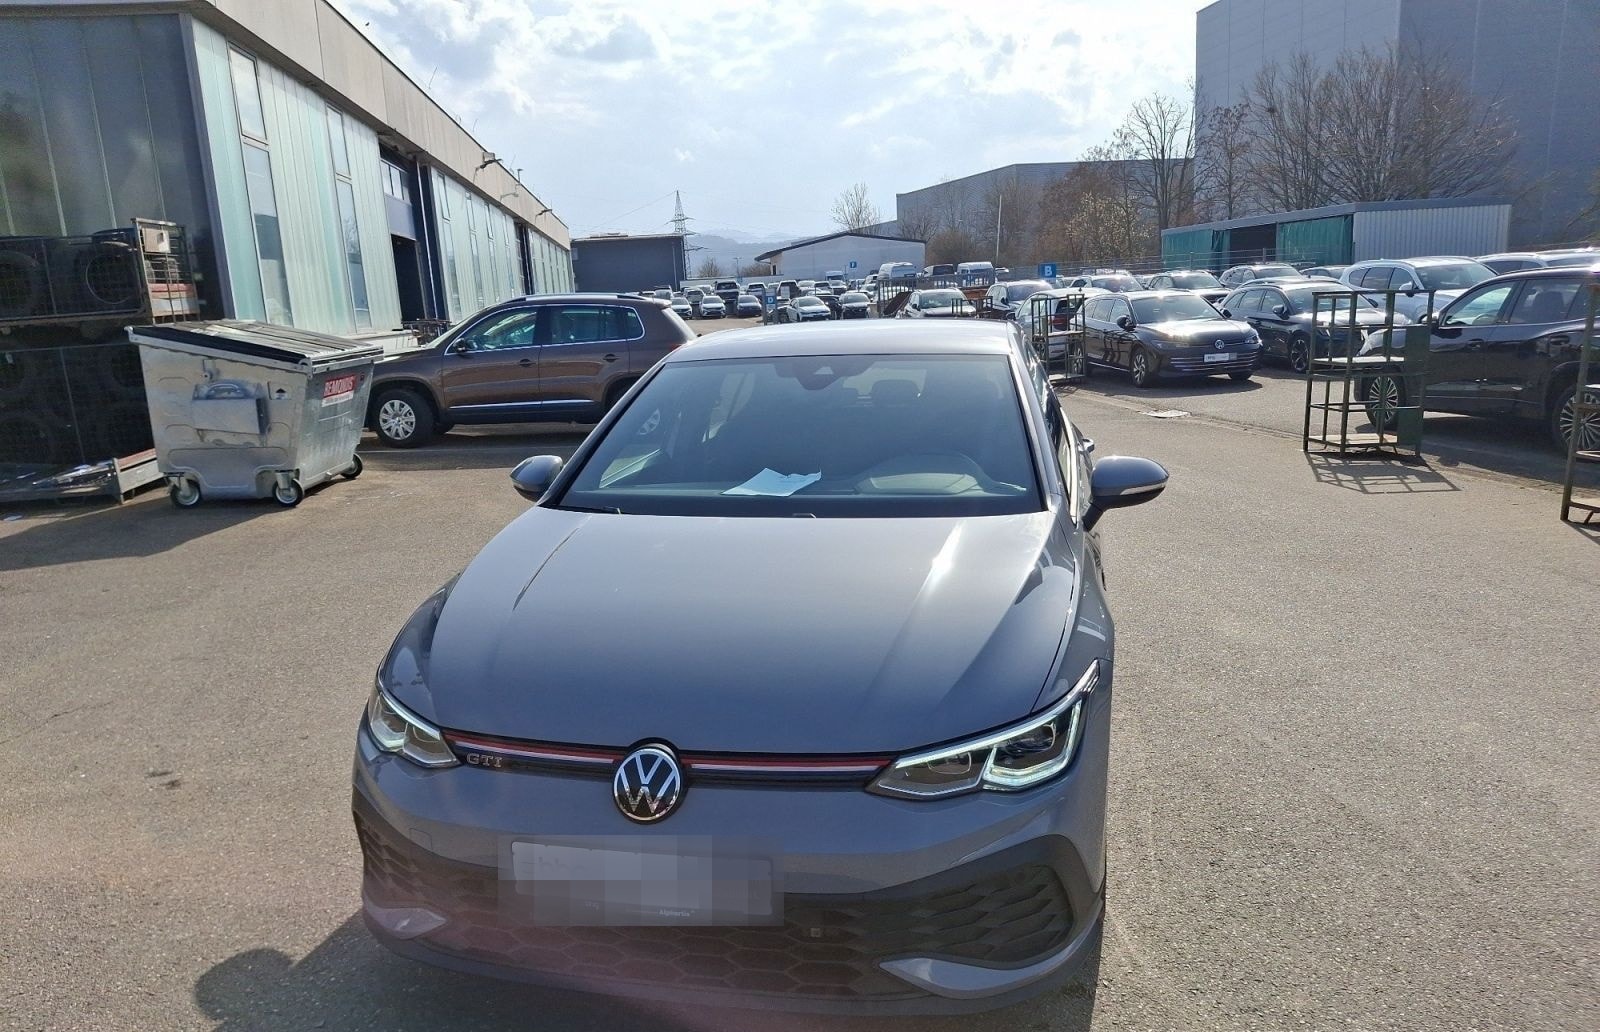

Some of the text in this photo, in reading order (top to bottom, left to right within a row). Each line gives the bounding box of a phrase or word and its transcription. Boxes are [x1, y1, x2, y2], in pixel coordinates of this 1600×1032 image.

[1044, 265, 1053, 277] B
[466, 753, 503, 768] GTI
[614, 748, 681, 820] VW
